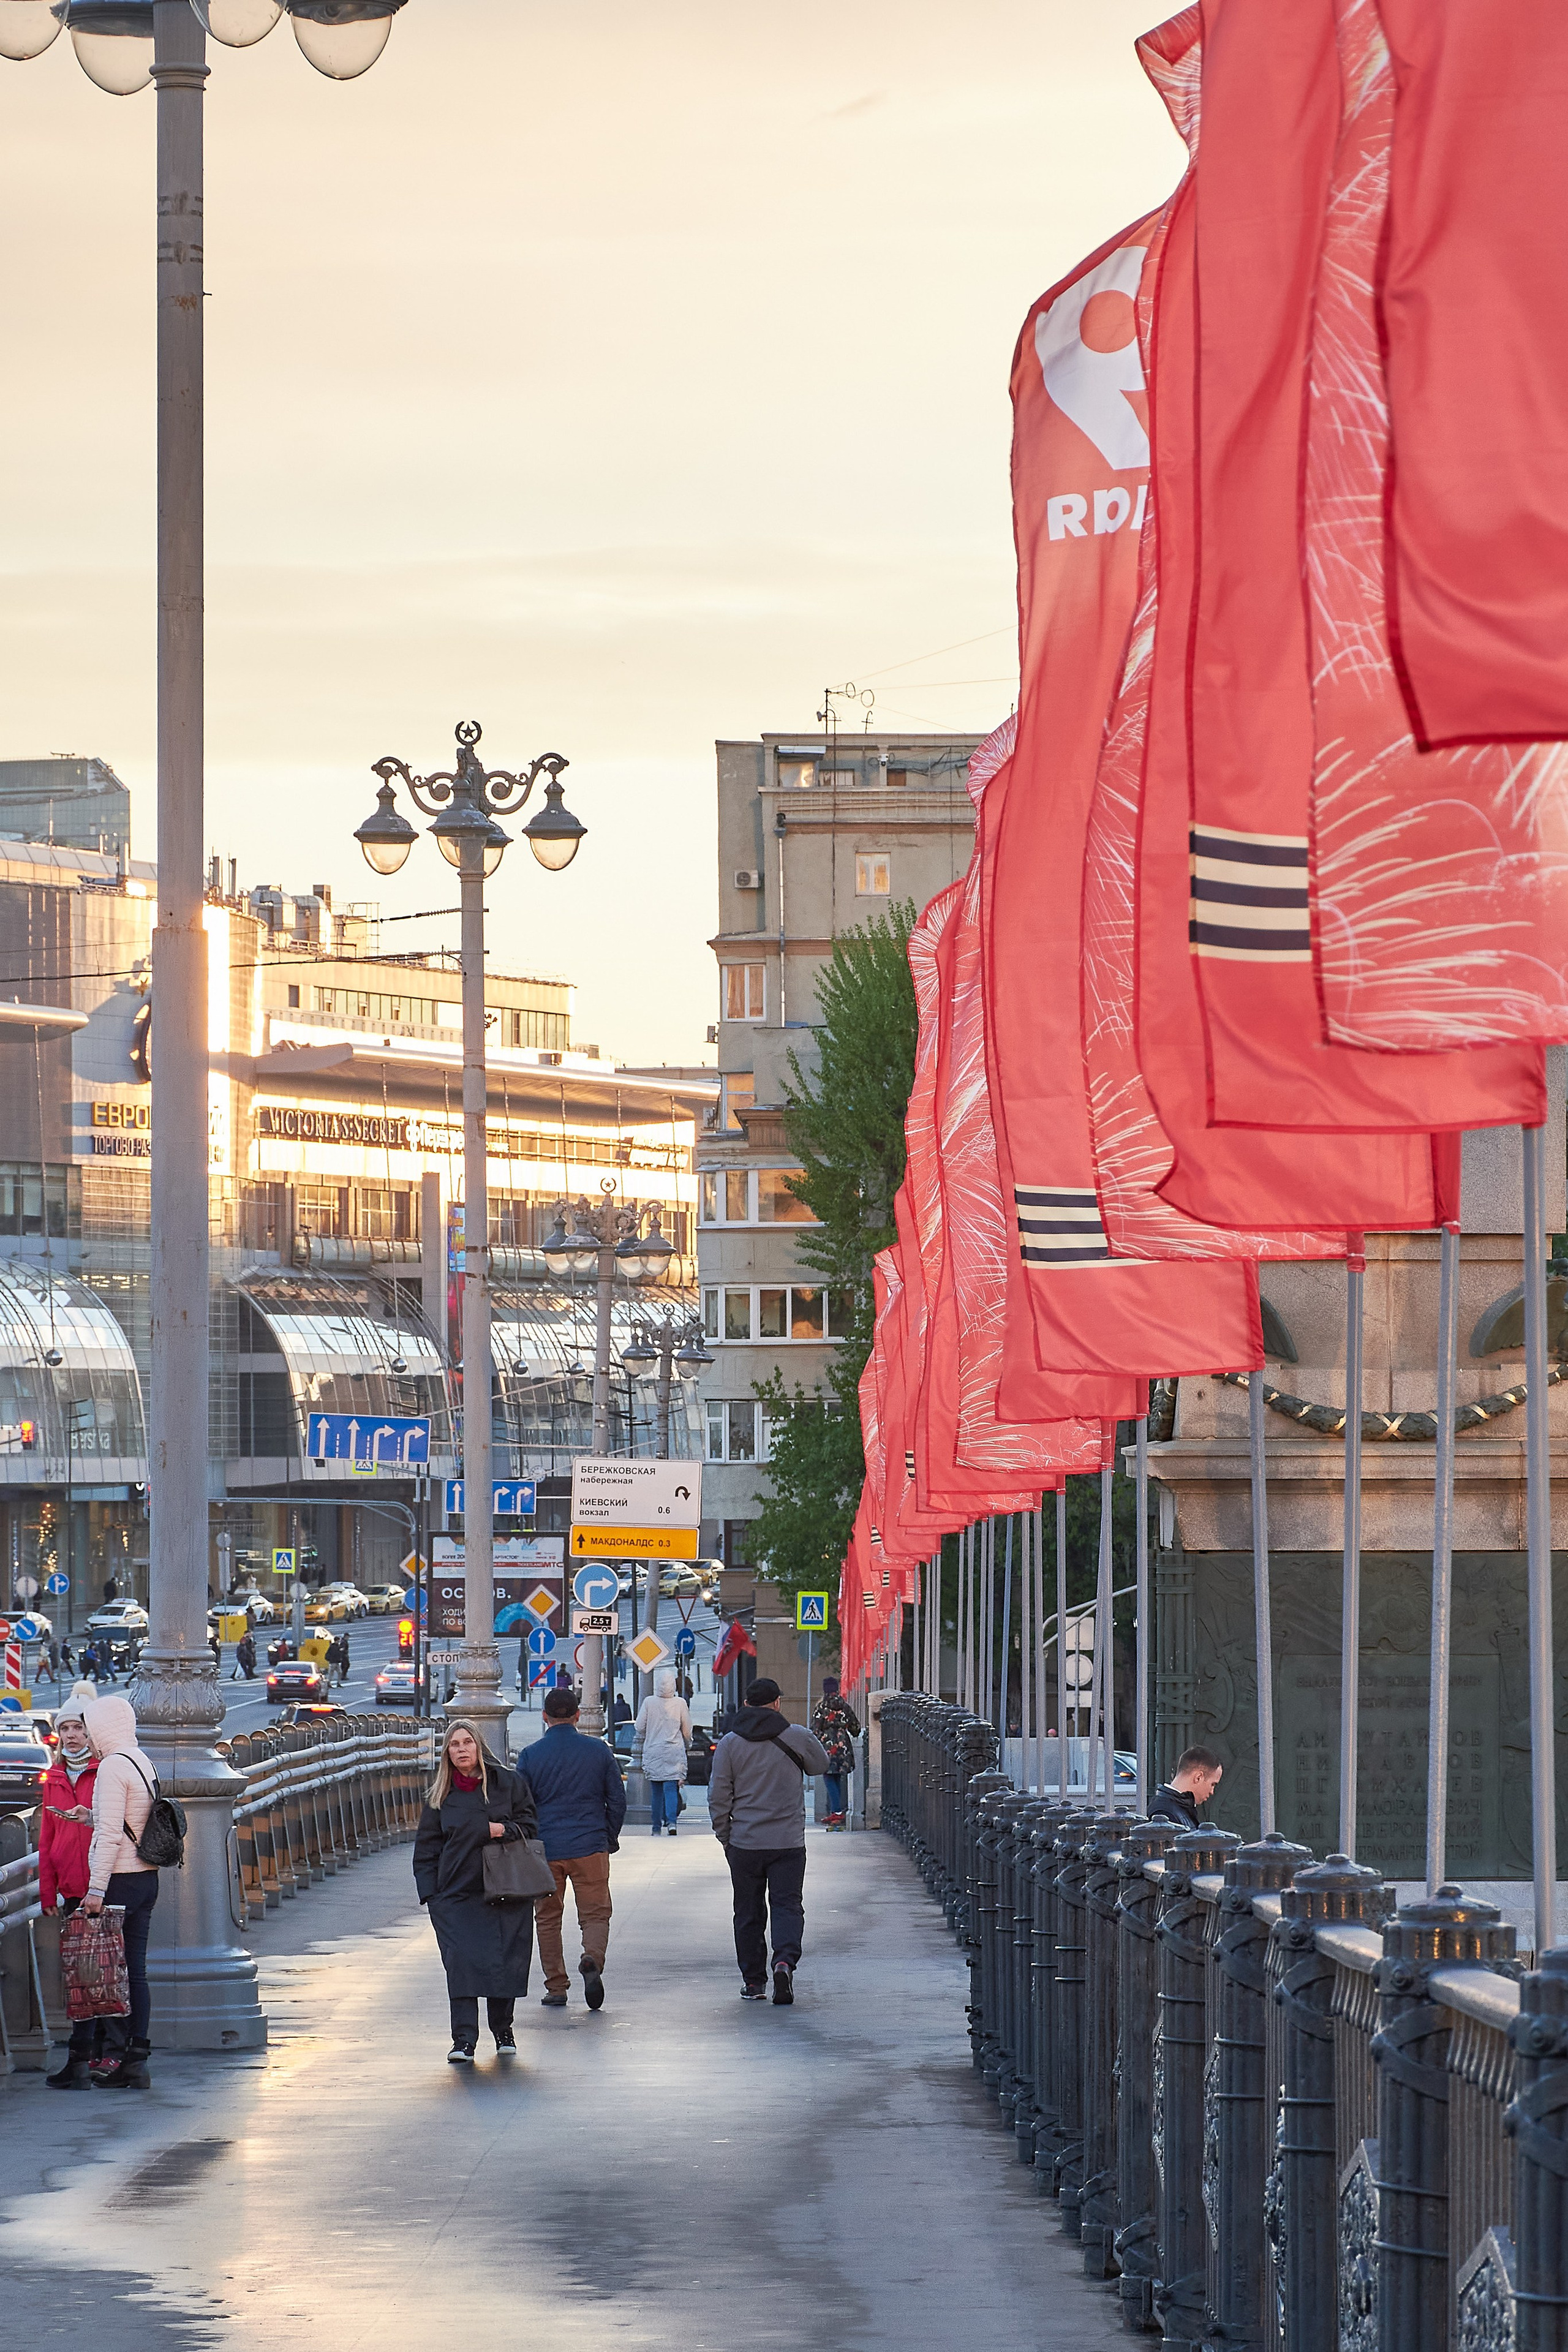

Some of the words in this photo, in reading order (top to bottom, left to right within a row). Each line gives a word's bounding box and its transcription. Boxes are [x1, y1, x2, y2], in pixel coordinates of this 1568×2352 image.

[268, 1107, 349, 1139] VICTORIA'S
[353, 1114, 405, 1144] SECRET
[581, 1466, 656, 1475] БЕРЕЖКОВСКАЯ
[579, 1498, 628, 1506] КИЕВСКИЙ
[590, 1537, 654, 1547] МАКДОНАЛДС
[400, 1634, 413, 1646] 21
